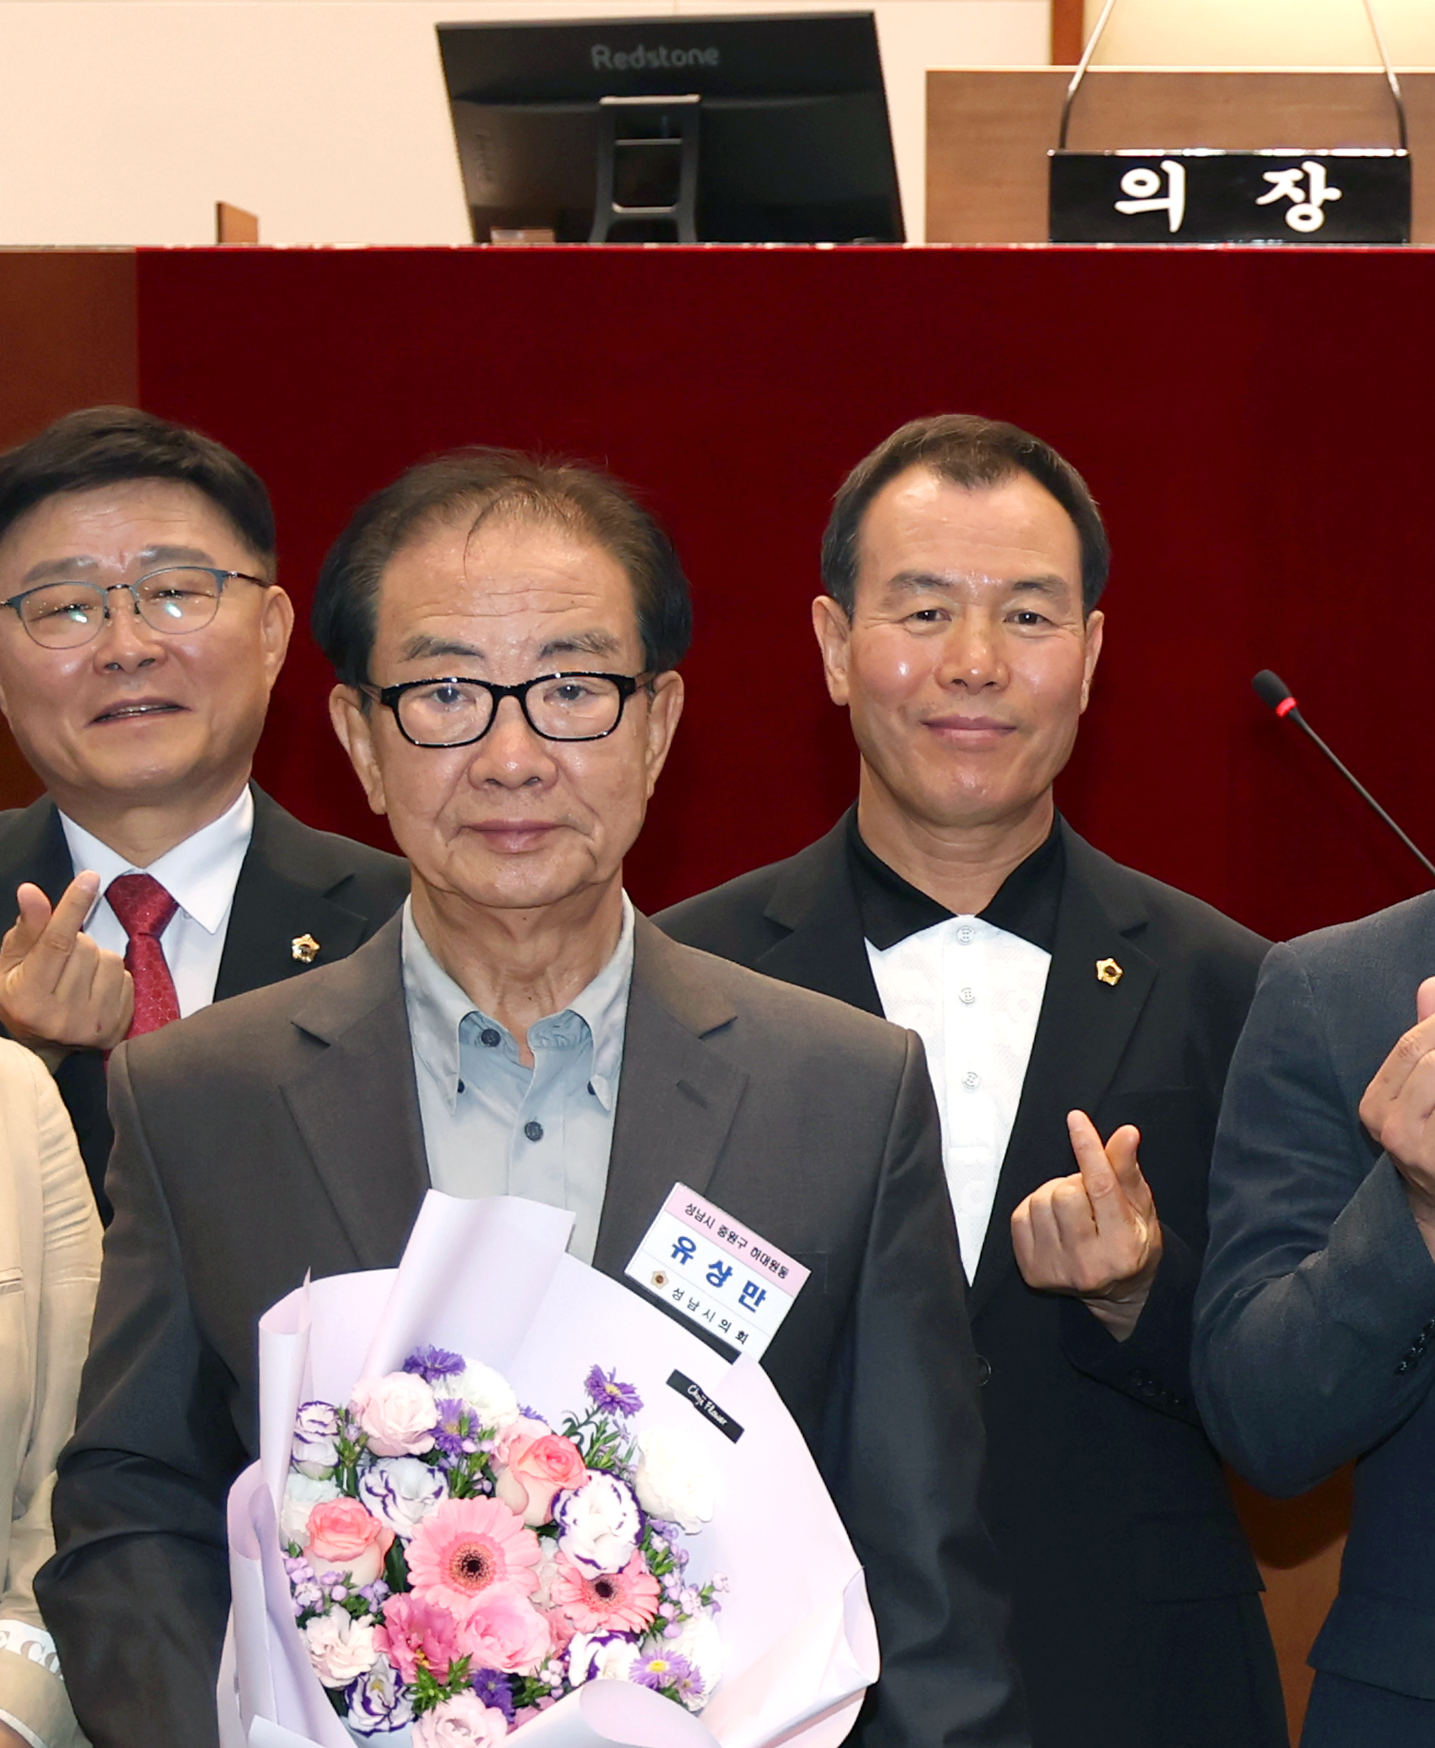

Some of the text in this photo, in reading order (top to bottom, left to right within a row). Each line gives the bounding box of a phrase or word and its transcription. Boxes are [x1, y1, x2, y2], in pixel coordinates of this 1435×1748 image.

[590, 43, 721, 70] Redstone
[684, 1203, 790, 1280] 성남시 중원구 하대원동
